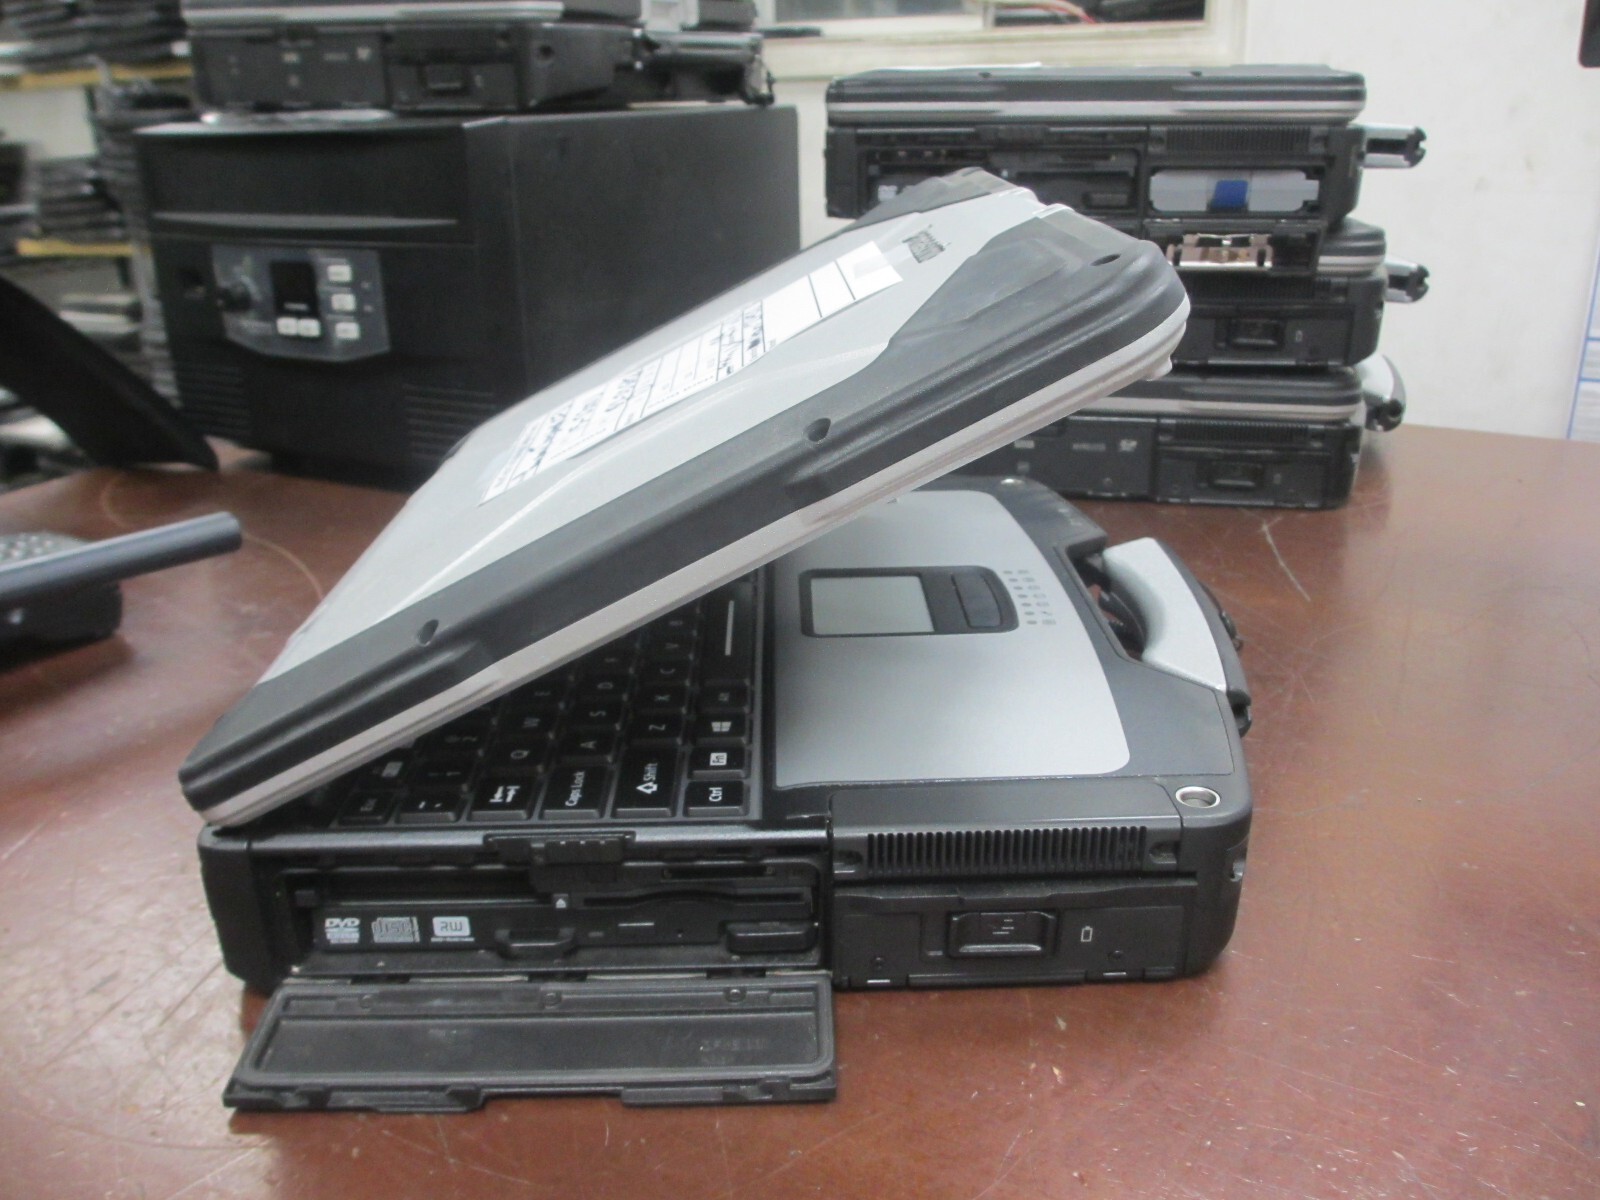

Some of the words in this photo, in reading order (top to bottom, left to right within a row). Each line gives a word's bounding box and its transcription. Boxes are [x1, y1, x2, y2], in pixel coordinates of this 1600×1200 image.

[580, 741, 597, 749] A
[510, 750, 530, 760] Q
[570, 771, 586, 788] Lock
[643, 763, 658, 782] Shift
[565, 788, 583, 807] Caps
[709, 787, 723, 802] Ctrl
[325, 917, 361, 929] DVD
[439, 920, 464, 933] RW
